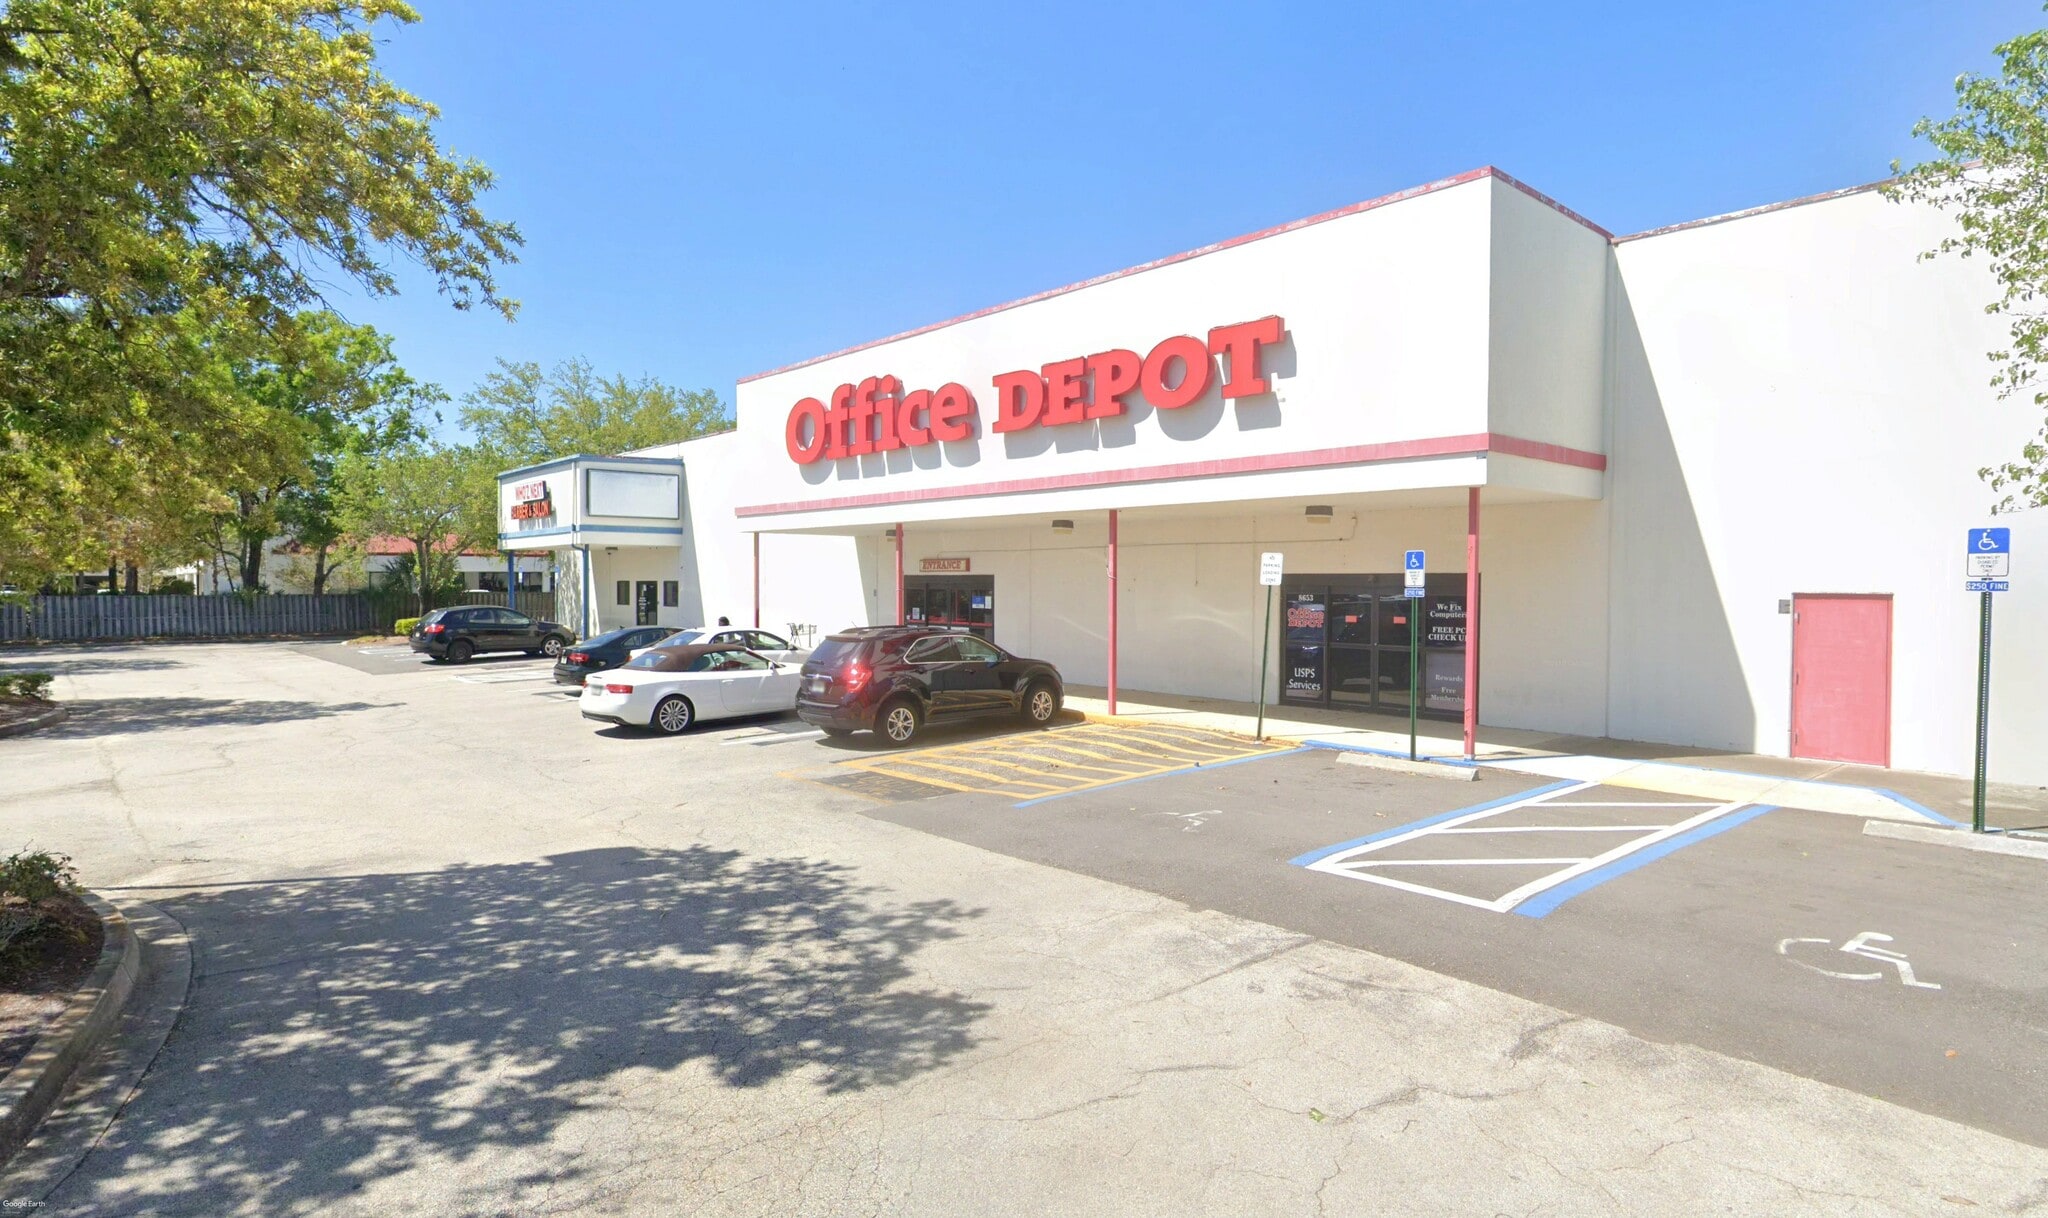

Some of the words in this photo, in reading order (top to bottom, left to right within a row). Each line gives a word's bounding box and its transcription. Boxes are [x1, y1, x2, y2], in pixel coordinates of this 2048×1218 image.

[785, 374, 977, 465] Office
[992, 315, 1287, 434] DEPOT
[922, 559, 962, 570] ENTRANCE
[1966, 582, 1987, 591] $250
[1989, 582, 2009, 590] FINE
[1436, 603, 1448, 611] We
[1449, 602, 1462, 611] Fix
[1287, 608, 1324, 620] Office
[1288, 619, 1324, 628] DEPOT
[1428, 633, 1457, 641] CHECK
[1294, 667, 1316, 679] USPS
[1435, 674, 1463, 682] Rewards
[1288, 678, 1321, 691] Services
